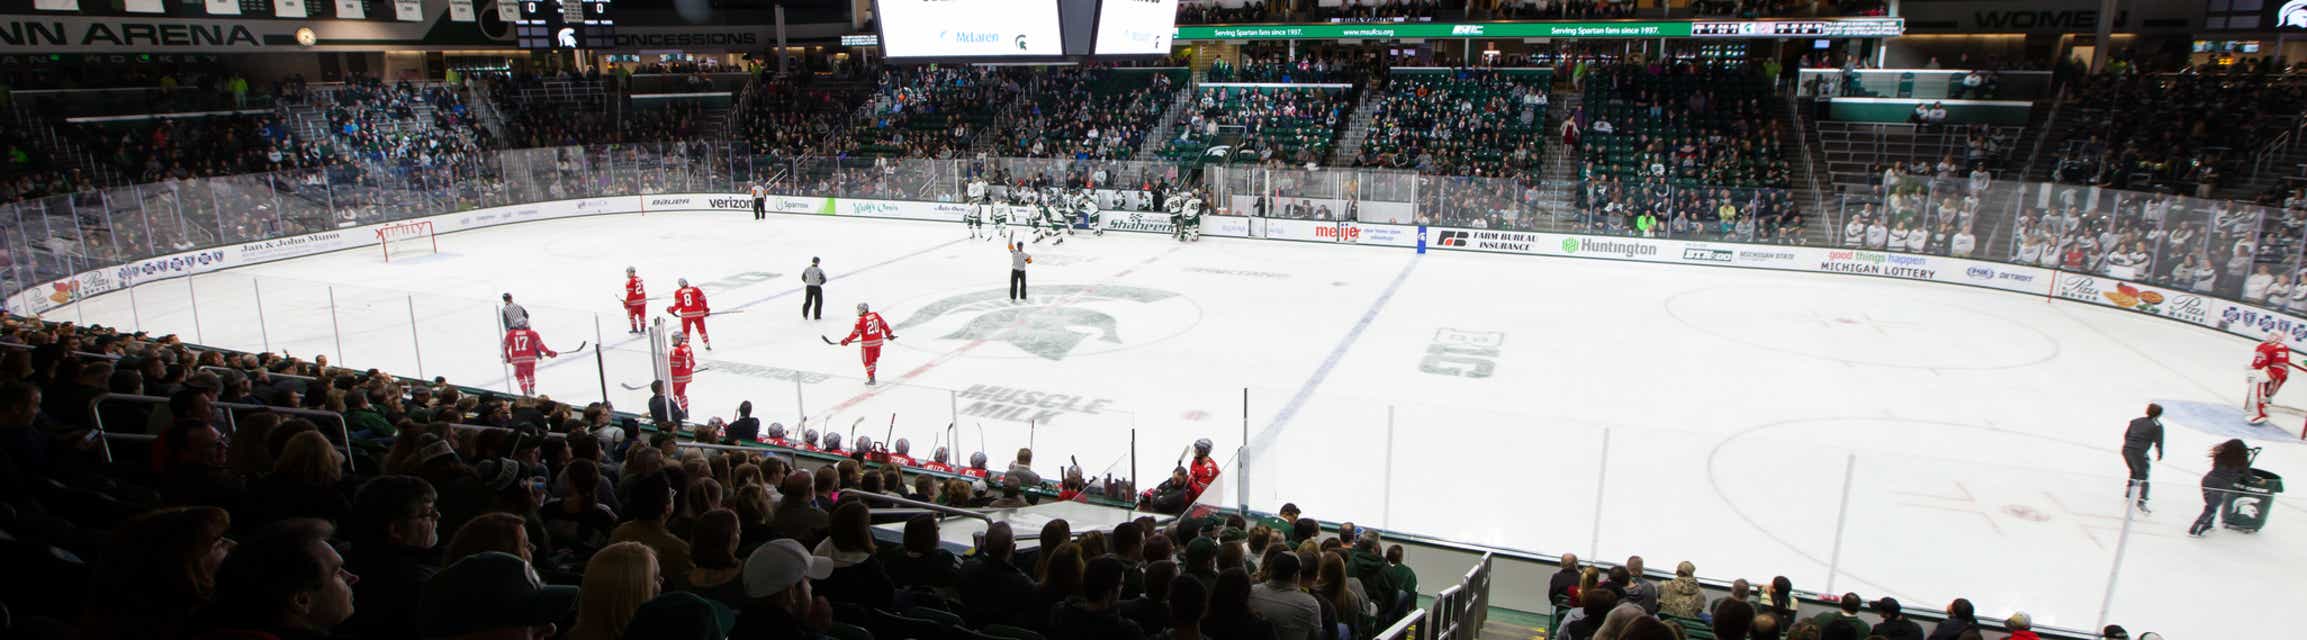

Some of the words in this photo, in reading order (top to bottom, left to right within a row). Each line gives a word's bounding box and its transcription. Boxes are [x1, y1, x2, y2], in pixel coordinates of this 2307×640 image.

[82, 23, 260, 46] ARENA
[956, 31, 999, 43] McLaren
[1551, 27, 1577, 36] Serving
[1578, 27, 1604, 36] Spartan
[1605, 26, 1620, 35] fans
[1621, 27, 1640, 35] since
[615, 33, 757, 47] ONCESSIONS
[708, 196, 753, 209] verizon
[1315, 223, 1361, 241] meijer
[1473, 231, 1499, 240] FARM
[1479, 241, 1531, 251] INSURANCE
[1581, 237, 1658, 257] Huntington
[1829, 251, 1854, 261] good
[1855, 252, 1886, 265] things
[1888, 253, 1927, 266] happen
[1821, 261, 1880, 274] MICHIGAN
[1884, 266, 1936, 280] LOTTERY
[683, 293, 692, 307] 8
[514, 335, 529, 352] 17
